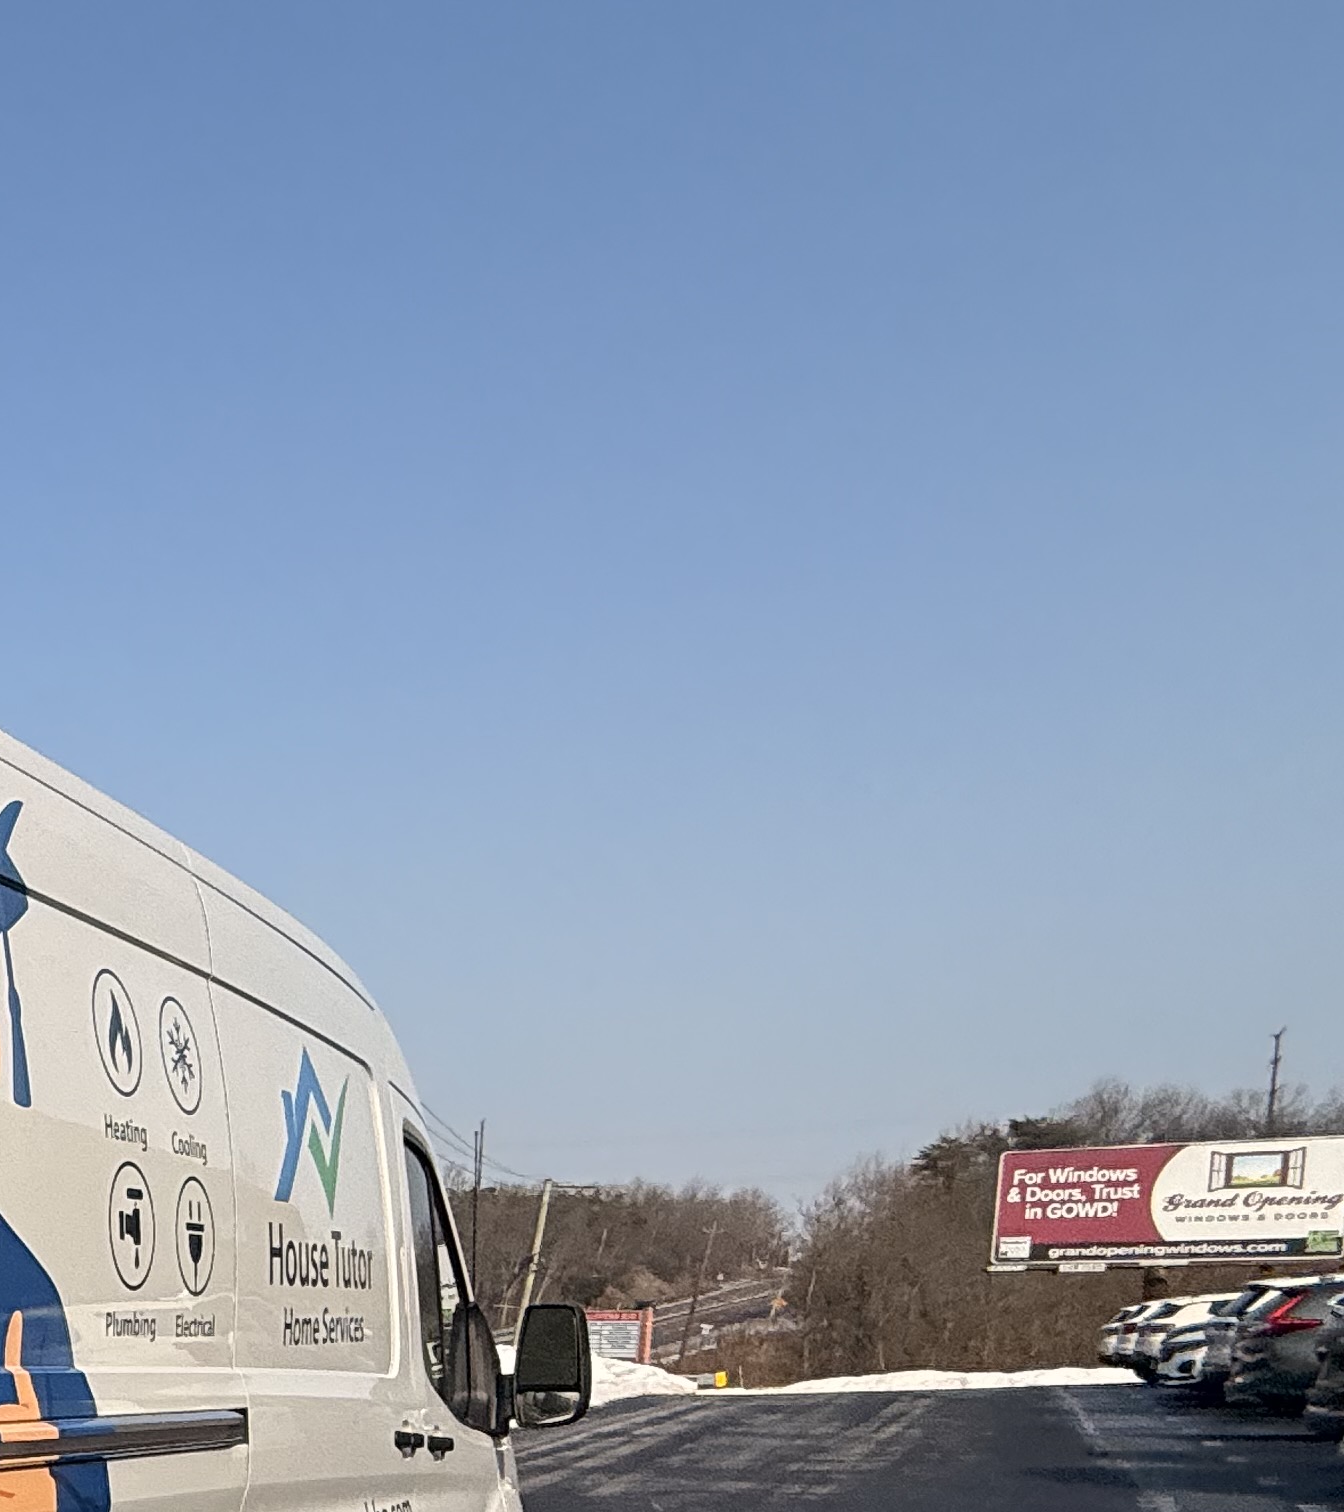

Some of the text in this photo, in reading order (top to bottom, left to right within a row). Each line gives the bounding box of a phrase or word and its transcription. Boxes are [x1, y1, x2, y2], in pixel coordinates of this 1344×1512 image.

[104, 1114, 148, 1151] Heating
[171, 1131, 207, 1166] Cooling
[1013, 1166, 1138, 1185] For Windows
[1006, 1183, 1141, 1203] & Doors, Trust
[1162, 1190, 1343, 1213] Grand Opening
[1025, 1201, 1119, 1219] in GOWD!
[1175, 1214, 1250, 1223] WINDOWS
[1273, 1212, 1329, 1221] DOORS
[268, 1221, 374, 1290] House Tutor
[1048, 1242, 1288, 1259] grandopeningwindows.com
[105, 1311, 156, 1342] Plumbing
[175, 1313, 216, 1338] Electrical
[283, 1307, 365, 1346] Home Services
